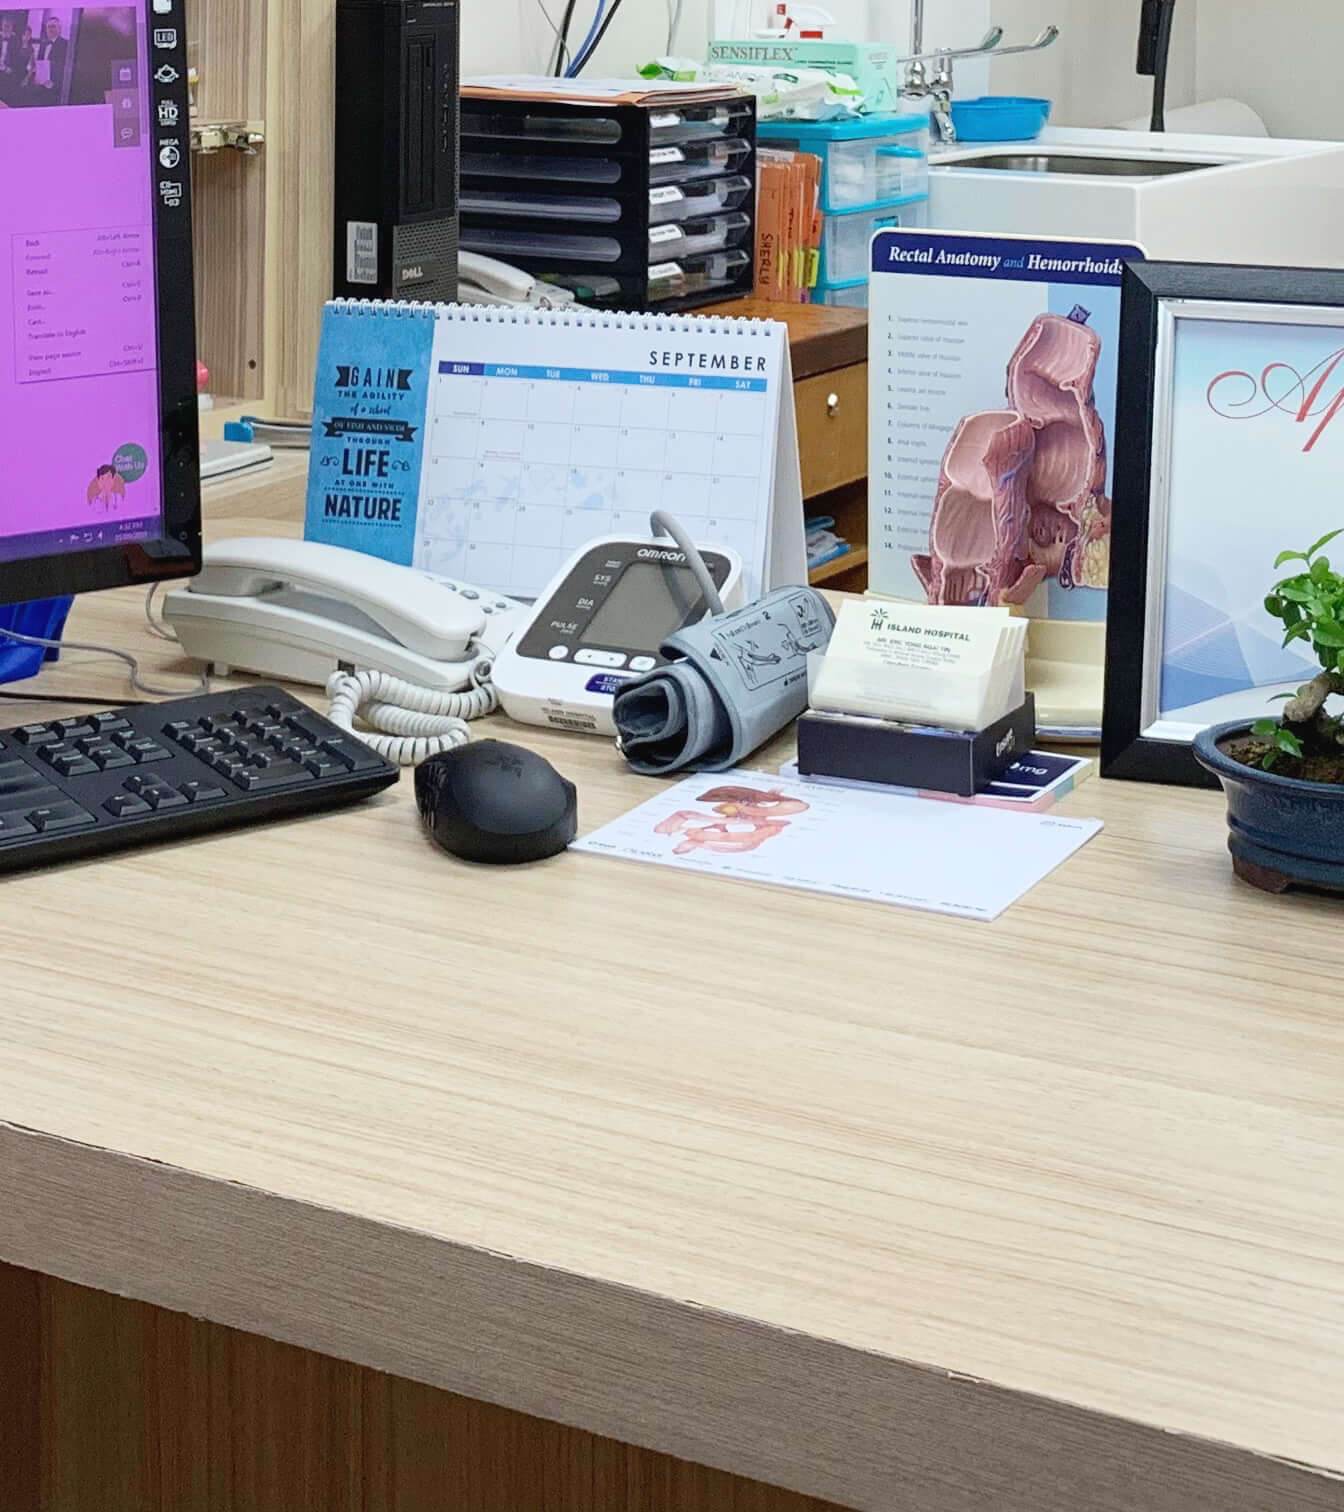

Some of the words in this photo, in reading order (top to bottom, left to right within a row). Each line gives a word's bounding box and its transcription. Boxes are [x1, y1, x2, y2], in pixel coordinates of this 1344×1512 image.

[158, 32, 174, 42] LED
[711, 45, 794, 61] SENSIFLEX
[158, 106, 178, 119] HD
[758, 232, 774, 286] SHERLY
[888, 245, 934, 264] Rectal
[935, 248, 1001, 272] Anatomy
[1003, 255, 1025, 268] and
[1027, 253, 1124, 275] Hemorrhoids
[401, 266, 424, 281] DELL
[649, 350, 767, 372] SEPTEMBER
[350, 366, 396, 389] GAIN
[452, 364, 470, 374] SUN
[496, 367, 519, 377] MON
[590, 372, 610, 382] WED
[639, 375, 656, 385] THU
[688, 377, 702, 387] FRI
[735, 380, 752, 389] SAT
[338, 390, 356, 399] THE
[368, 405, 392, 416] school
[366, 423, 383, 432] AND
[342, 448, 391, 478] LIFE
[349, 480, 368, 488] ONE
[372, 481, 395, 489] WITH
[324, 493, 402, 521] NATURE
[636, 548, 687, 563] OMRON
[593, 574, 612, 583] SYS
[577, 597, 595, 607] DIA
[761, 610, 772, 621] 2
[550, 620, 579, 631] PULSE
[887, 623, 922, 635] ISLAND
[923, 628, 971, 642] HOSPITAL
